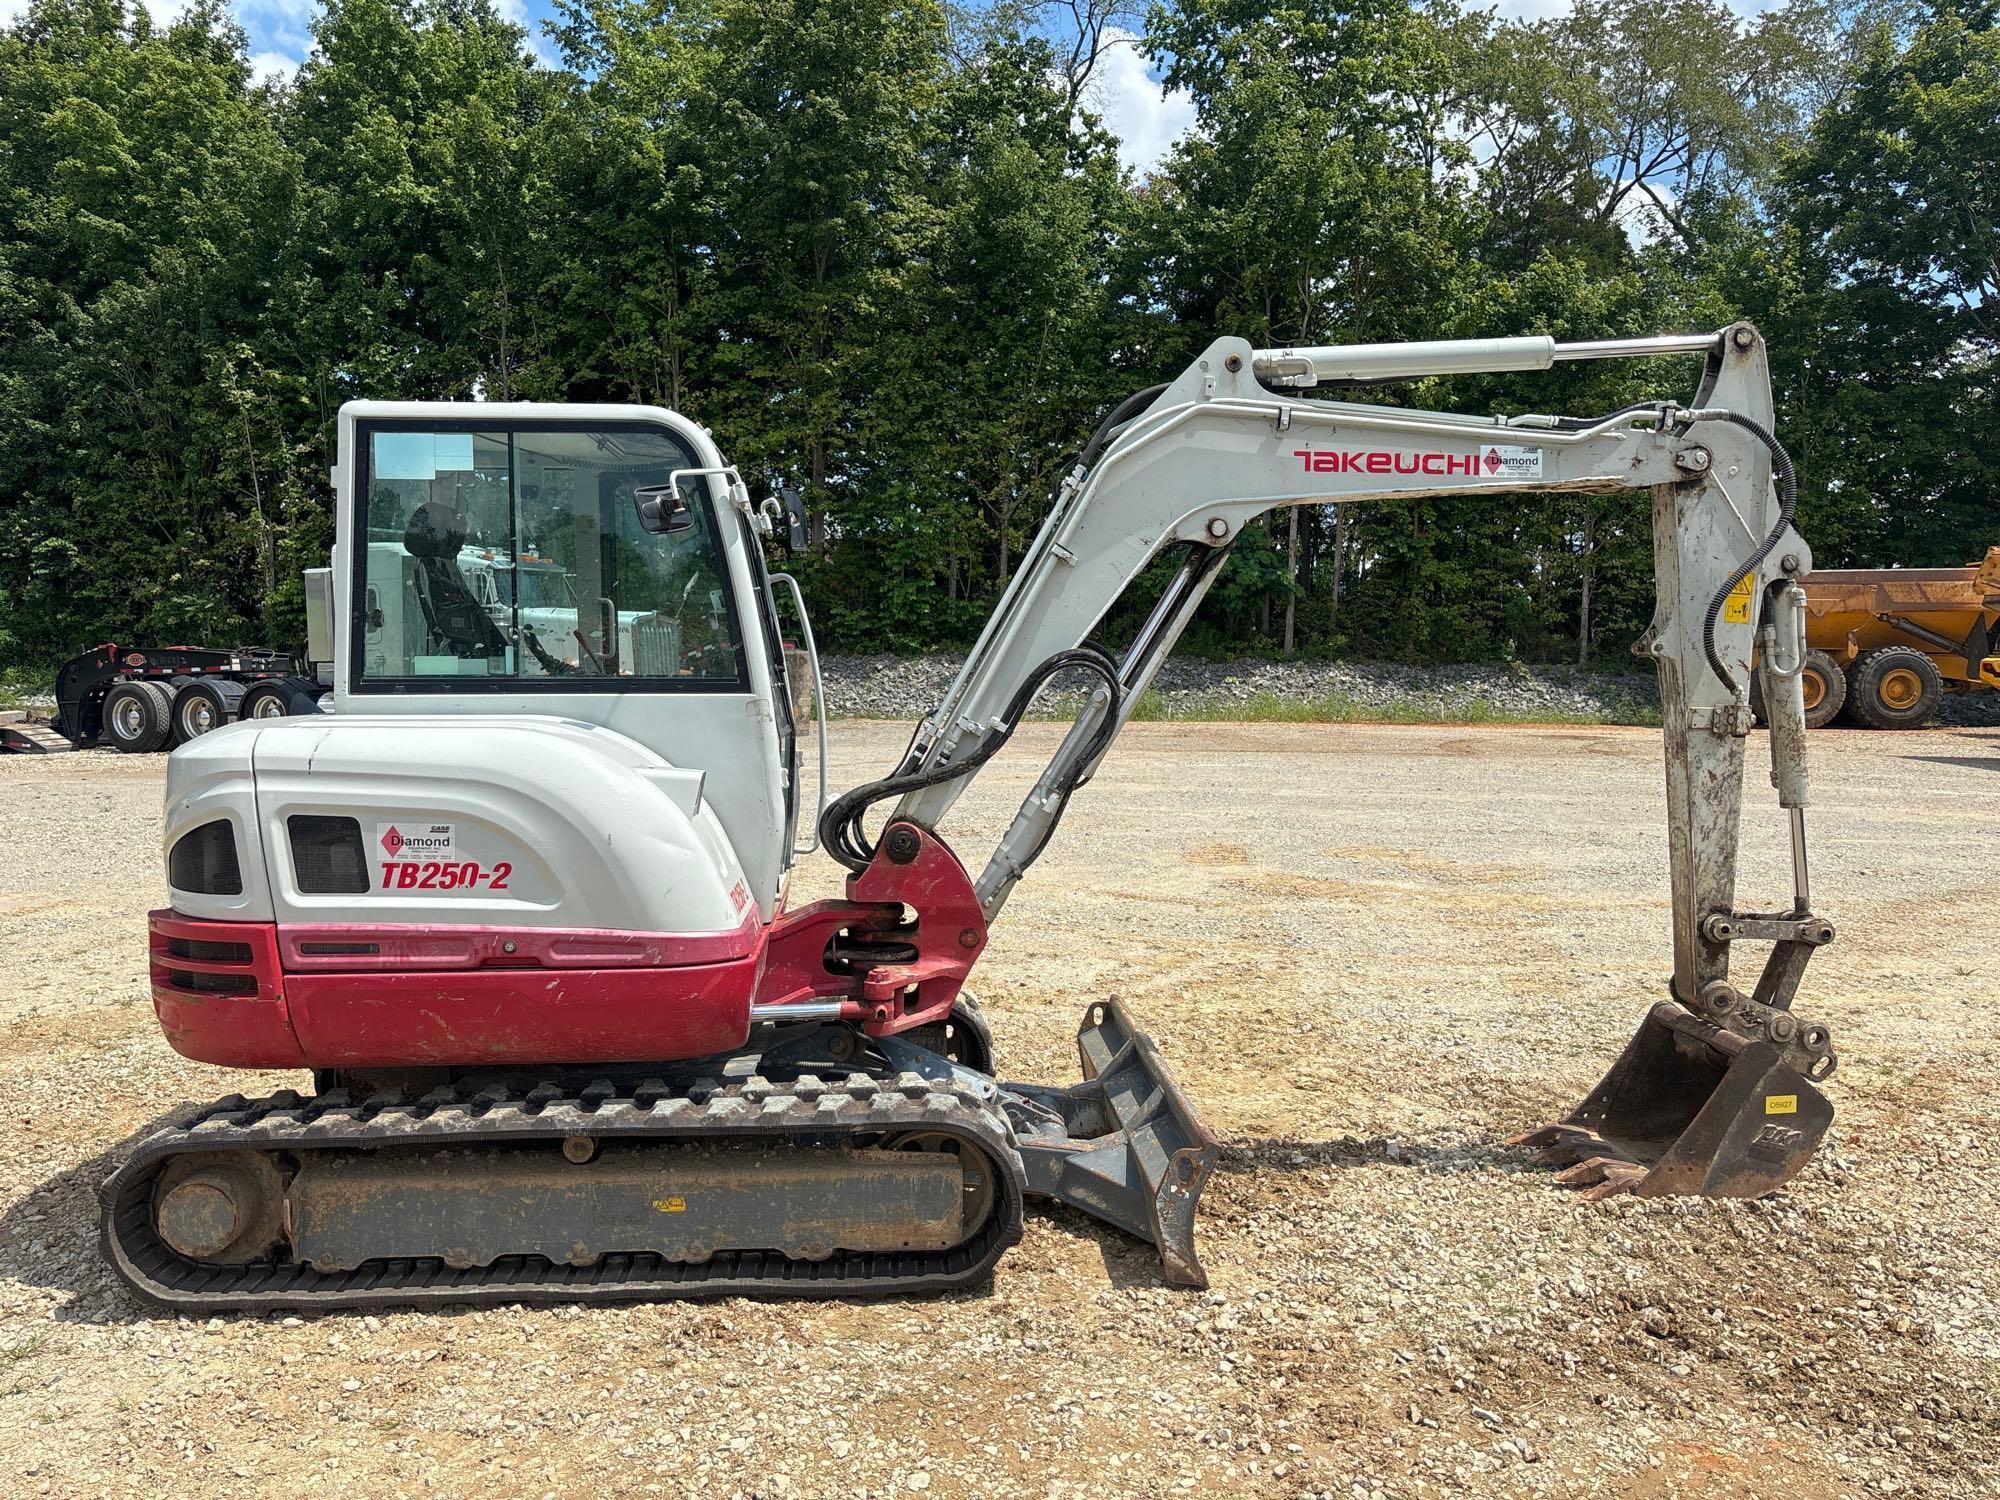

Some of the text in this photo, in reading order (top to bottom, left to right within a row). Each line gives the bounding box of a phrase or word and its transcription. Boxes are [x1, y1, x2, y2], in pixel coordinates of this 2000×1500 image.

[1491, 456, 1538, 465] Diamond
[391, 835, 450, 847] Diamond
[381, 862, 513, 890] TB250-2
